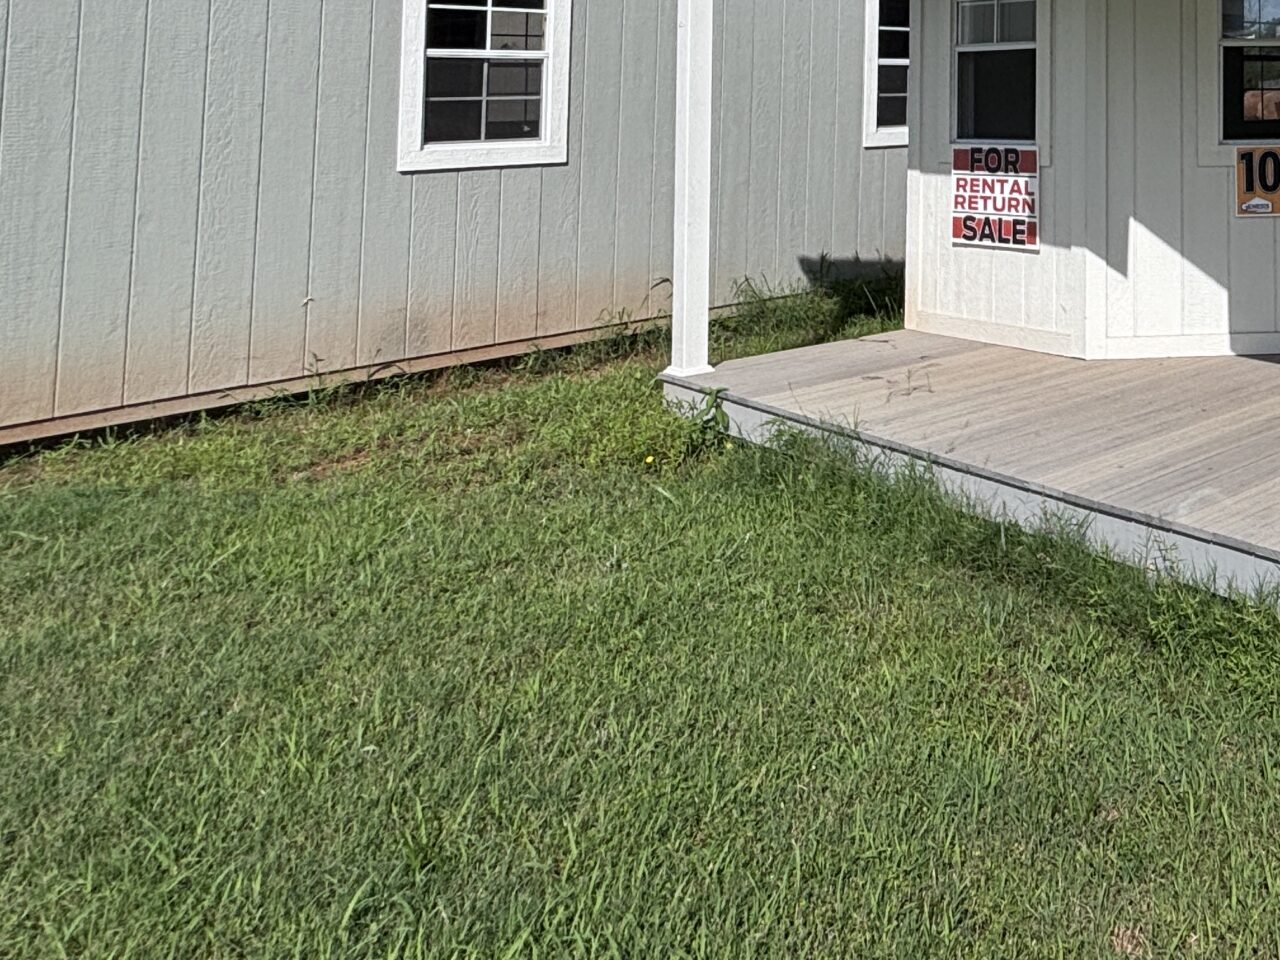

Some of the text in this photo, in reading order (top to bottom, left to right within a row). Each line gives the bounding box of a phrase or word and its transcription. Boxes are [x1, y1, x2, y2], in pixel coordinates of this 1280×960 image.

[970, 147, 1020, 174] FOR
[955, 177, 1035, 196] RENTAL
[954, 194, 1036, 214] RETURN
[962, 215, 1026, 246] SALE
